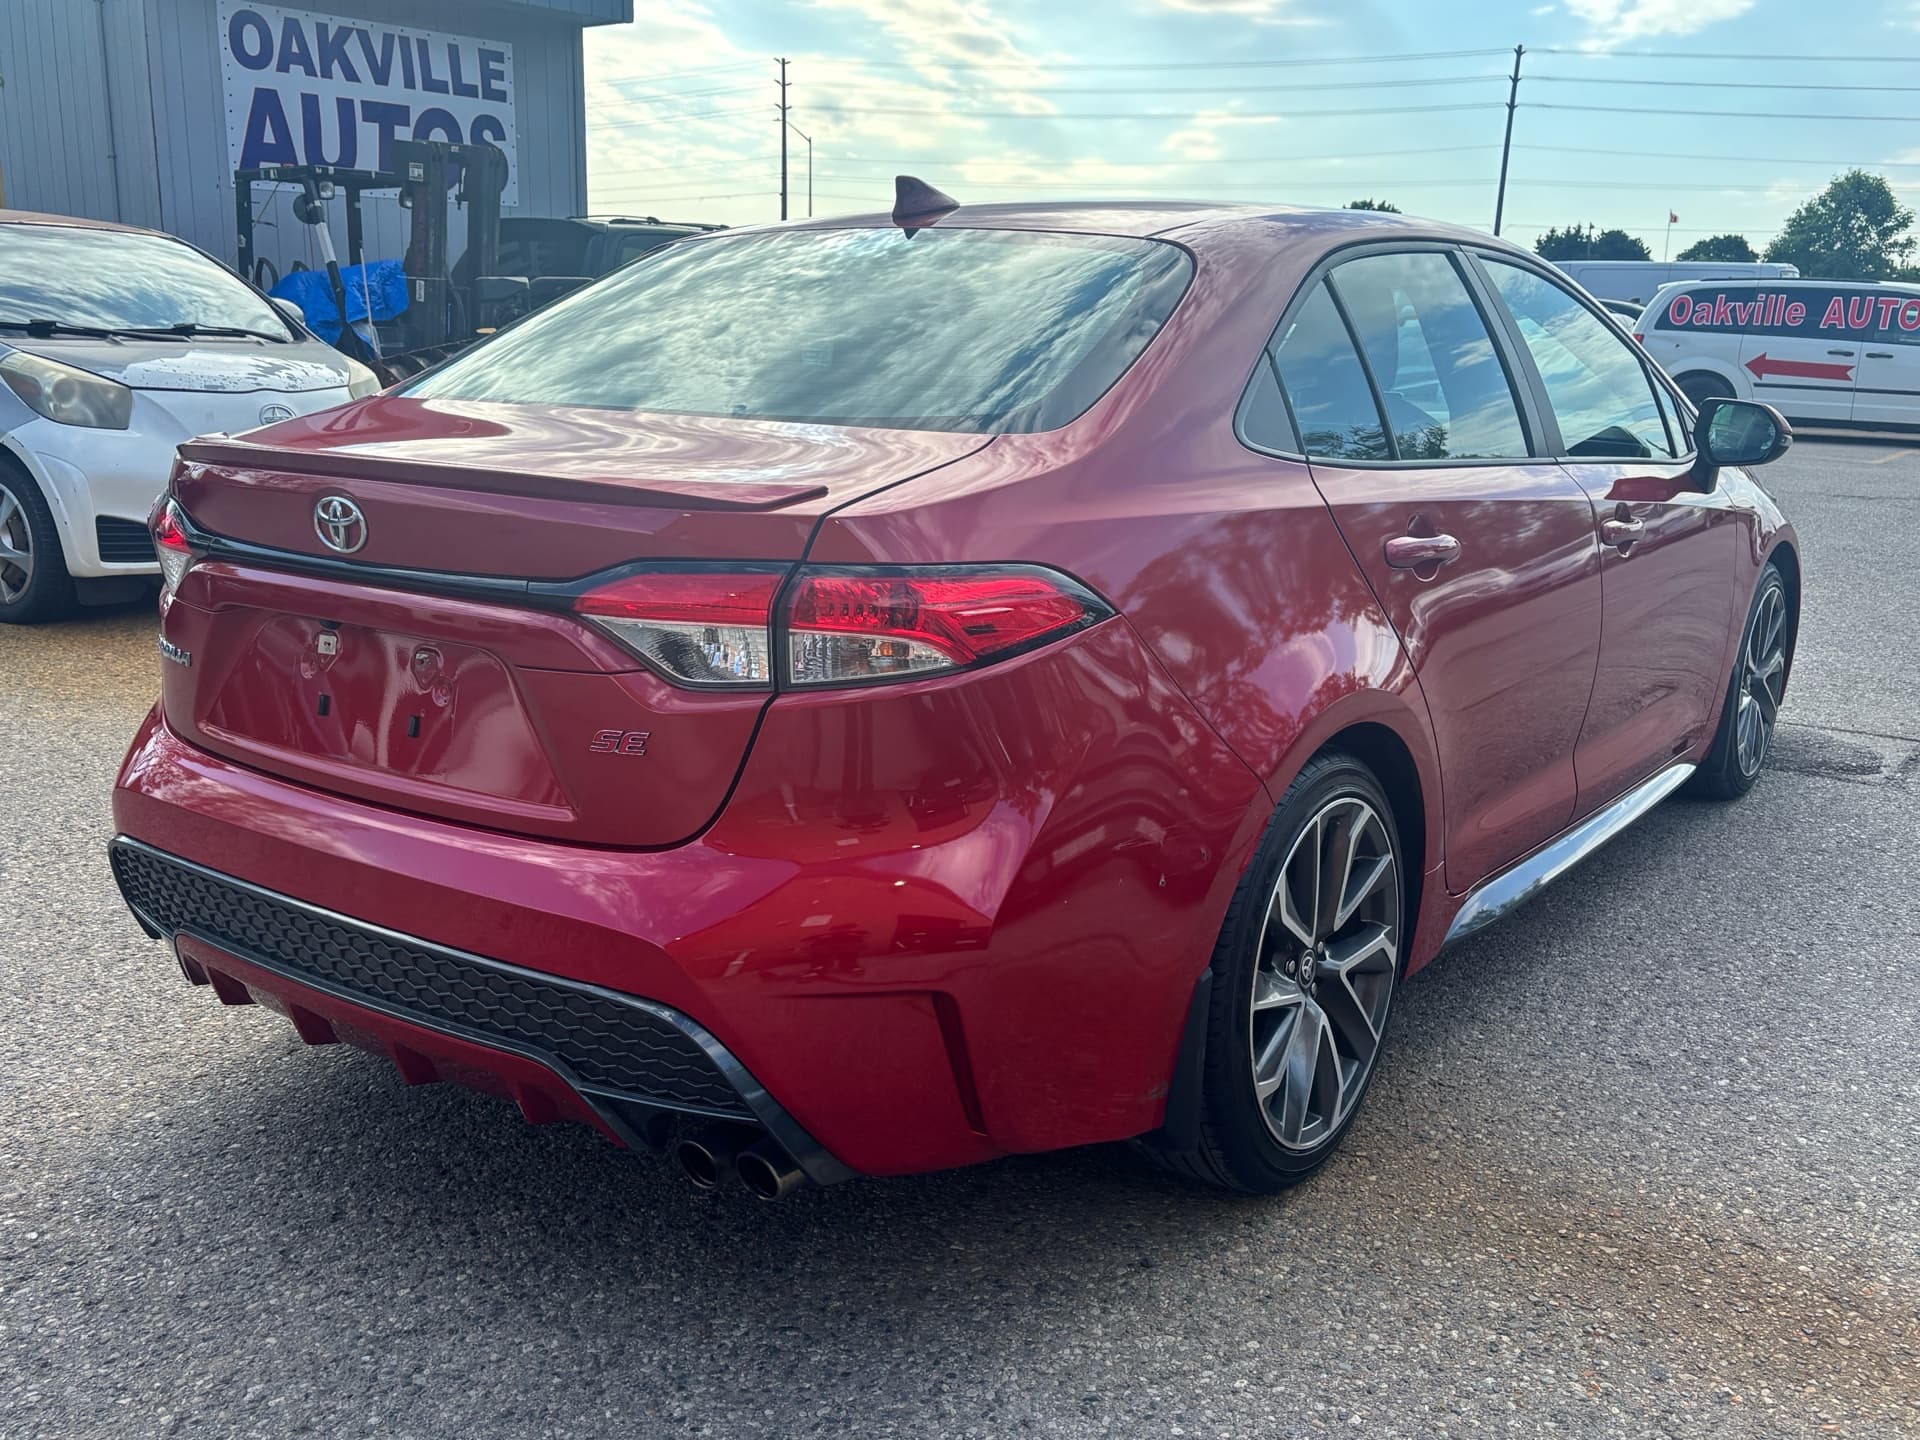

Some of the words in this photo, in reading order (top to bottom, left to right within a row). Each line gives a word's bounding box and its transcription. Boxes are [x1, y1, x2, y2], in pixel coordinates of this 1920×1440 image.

[229, 9, 507, 103] OAKVILLE
[1669, 294, 1806, 326] Oakville
[1819, 296, 1920, 331] AUTO
[589, 729, 651, 756] SE
